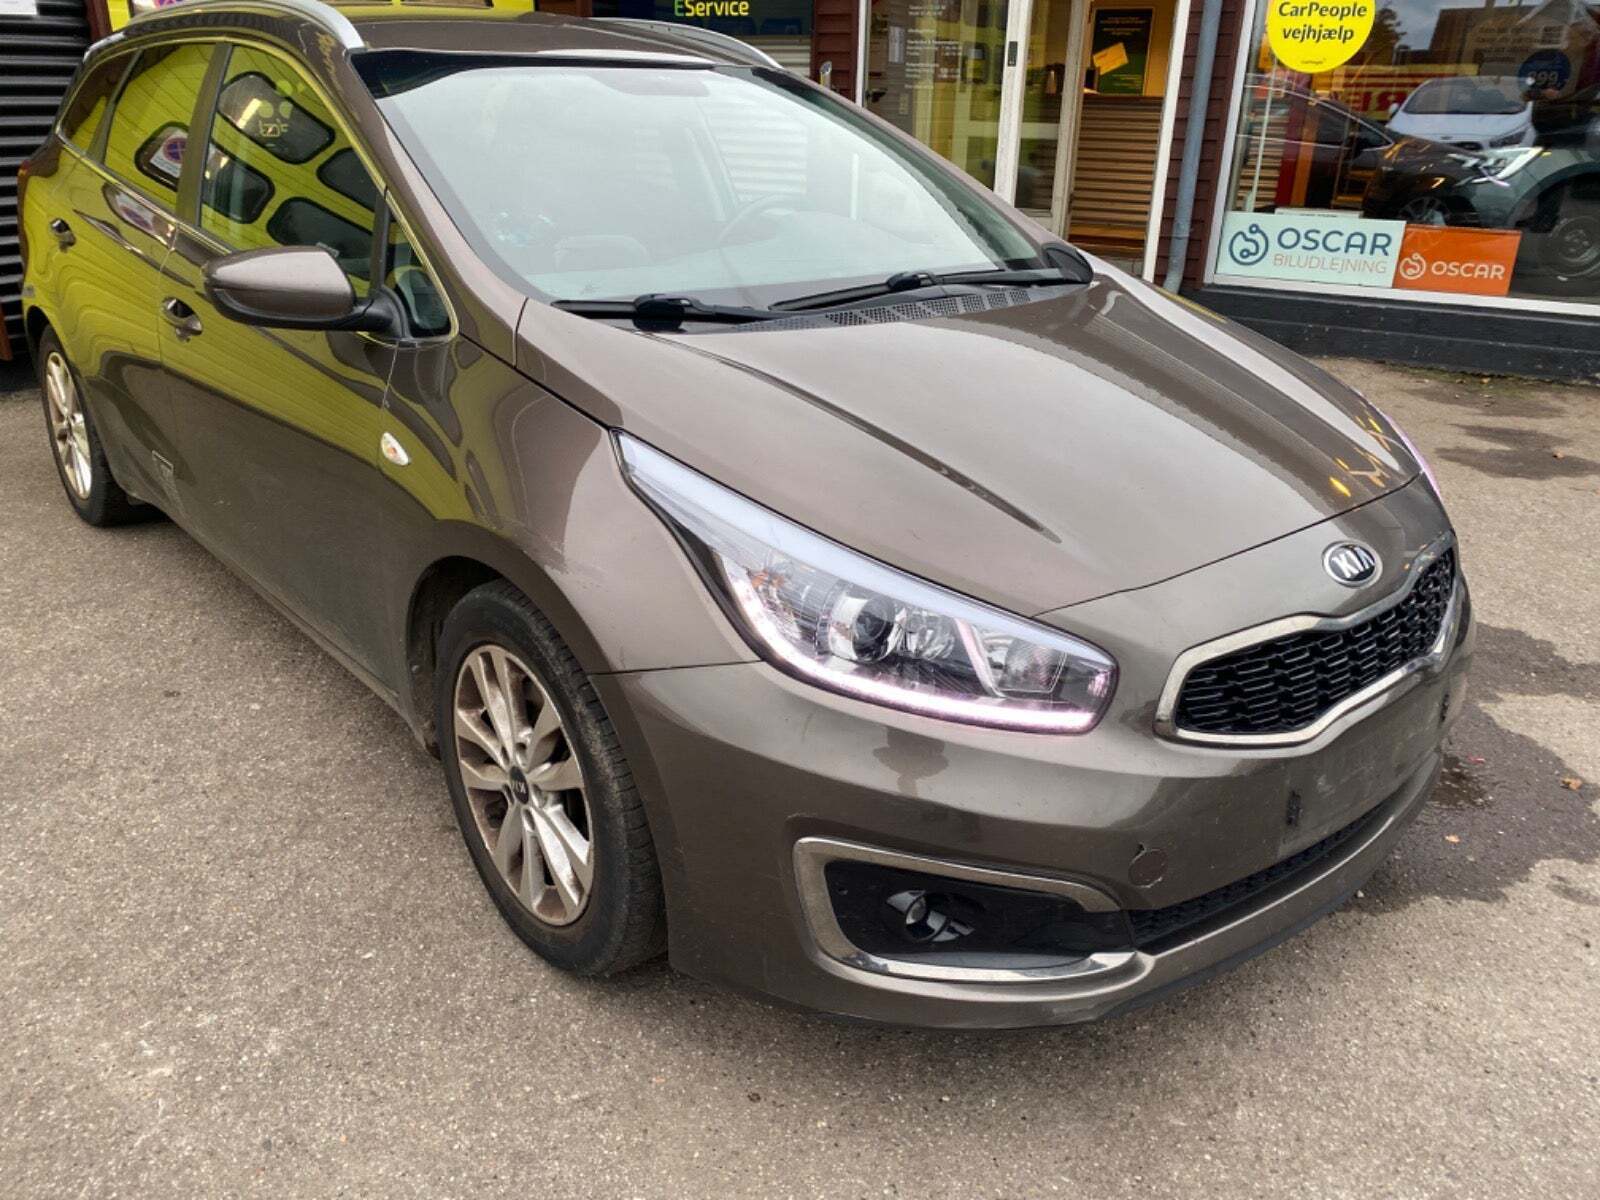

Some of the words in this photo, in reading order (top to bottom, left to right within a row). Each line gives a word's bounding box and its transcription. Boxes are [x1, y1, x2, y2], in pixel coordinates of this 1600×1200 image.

[674, 0, 749, 16] EService
[1278, 2, 1367, 21] CarPeople
[1282, 24, 1354, 44] vejhjælp
[1277, 227, 1392, 256] OSCAR
[1273, 253, 1388, 274] BILUDLEJNING
[1431, 260, 1506, 280] OSCAR
[1331, 546, 1376, 578] KIA
